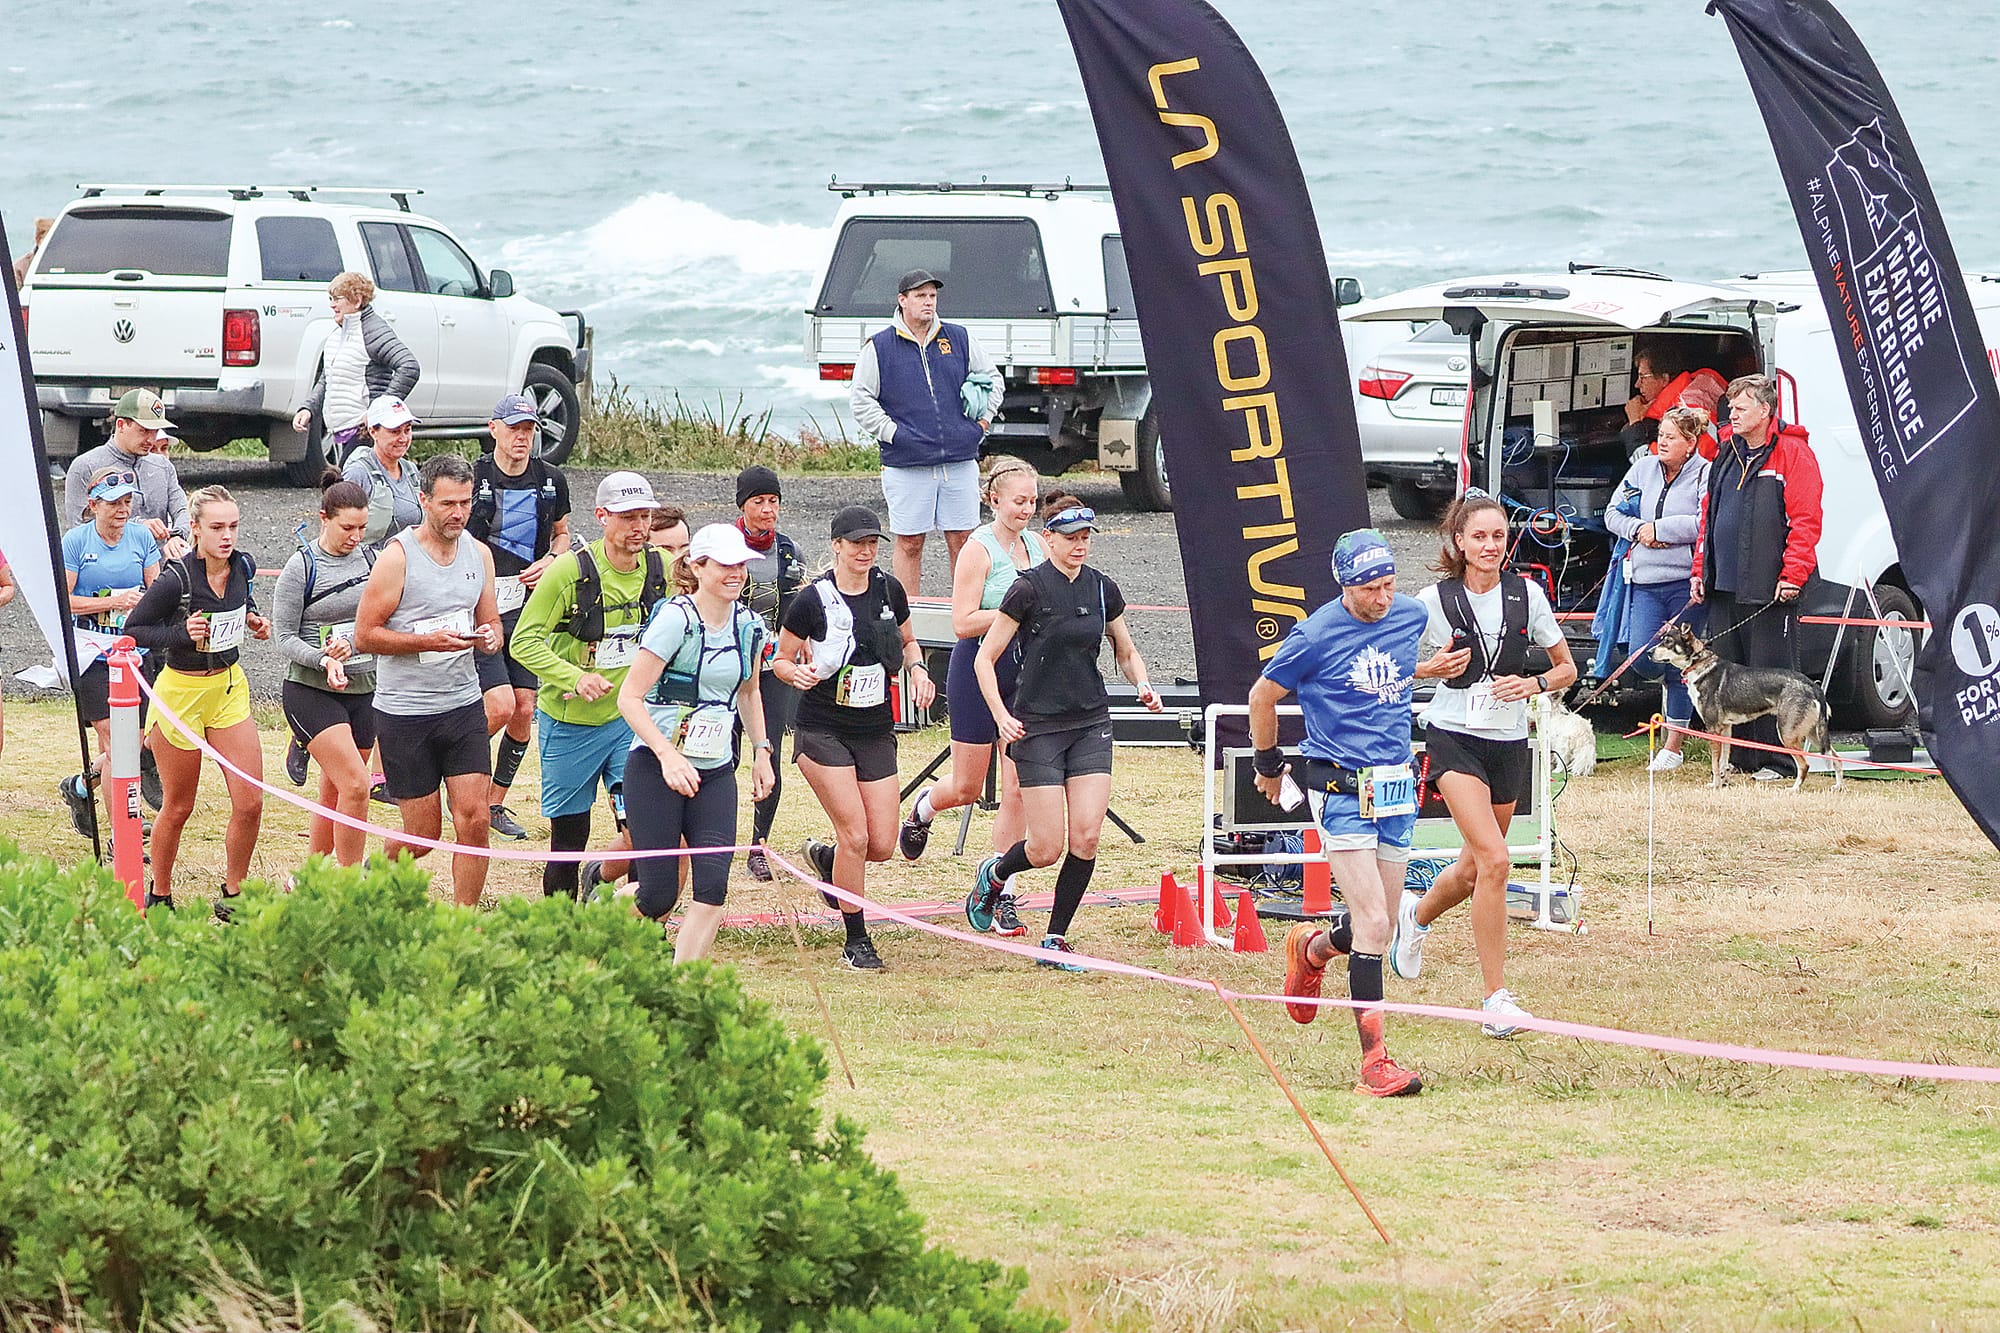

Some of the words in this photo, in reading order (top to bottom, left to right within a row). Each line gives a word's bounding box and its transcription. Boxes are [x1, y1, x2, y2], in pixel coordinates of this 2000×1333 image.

[1148, 47, 1219, 170] LA
[1904, 229, 1943, 331] ALPINE
[262, 305, 277, 316] V6
[1886, 243, 1924, 359] NATURE
[1864, 262, 1925, 441] EXPERIENCE
[621, 488, 645, 496] PURE
[852, 673, 880, 693] 1715
[1956, 679, 1995, 709] FOR
[689, 722, 723, 738] 1719
[1382, 780, 1408, 801] 1711
